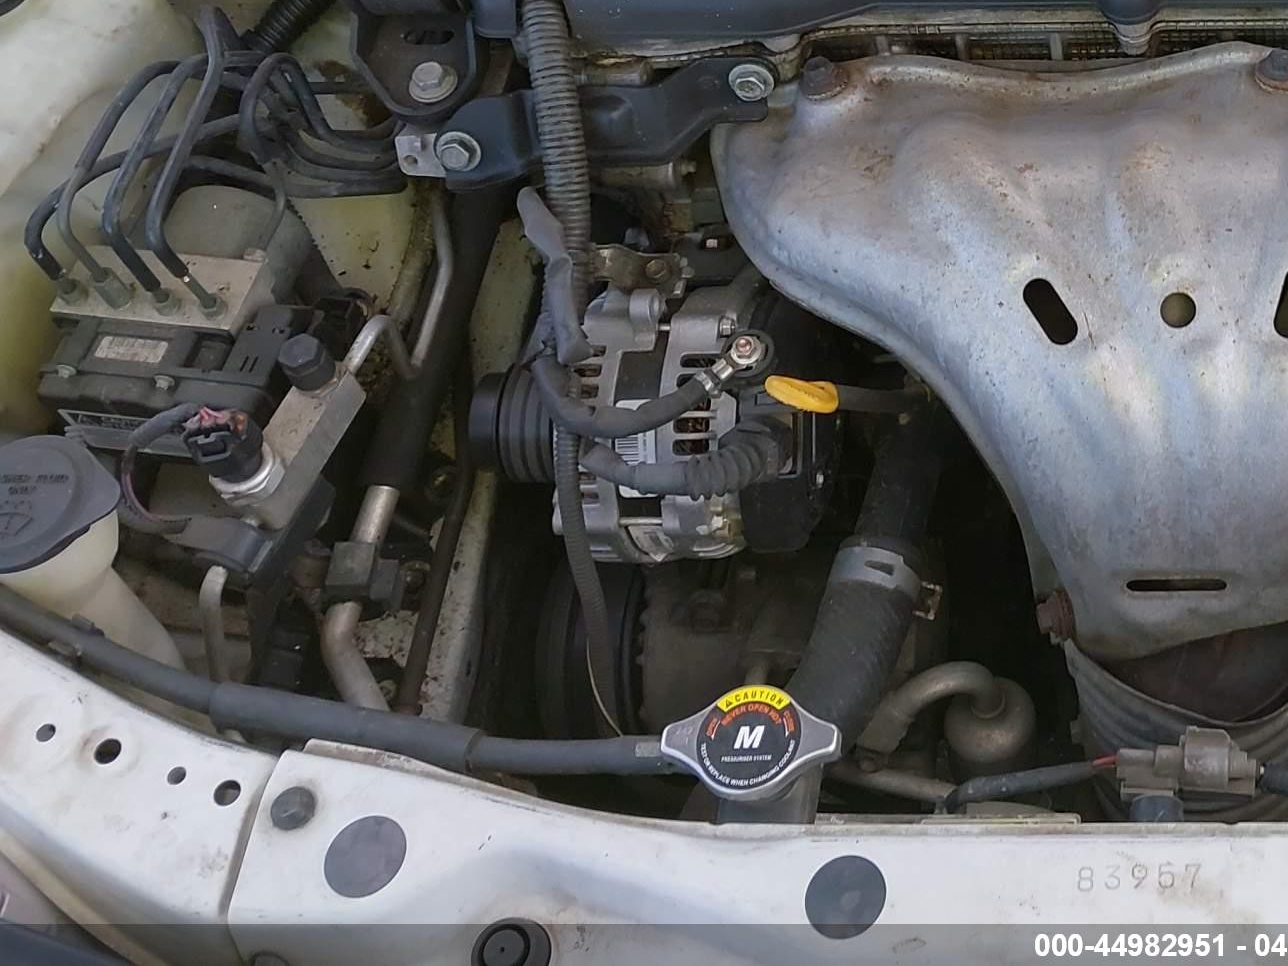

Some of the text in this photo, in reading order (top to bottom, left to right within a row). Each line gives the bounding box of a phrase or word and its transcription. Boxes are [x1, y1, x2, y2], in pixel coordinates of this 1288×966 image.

[734, 690, 786, 706] CAUTION
[747, 703, 770, 714] OPEN
[733, 725, 765, 750] M
[708, 765, 731, 785] REPLACE
[730, 778, 749, 787] WHEN
[749, 765, 780, 786] CHANGING
